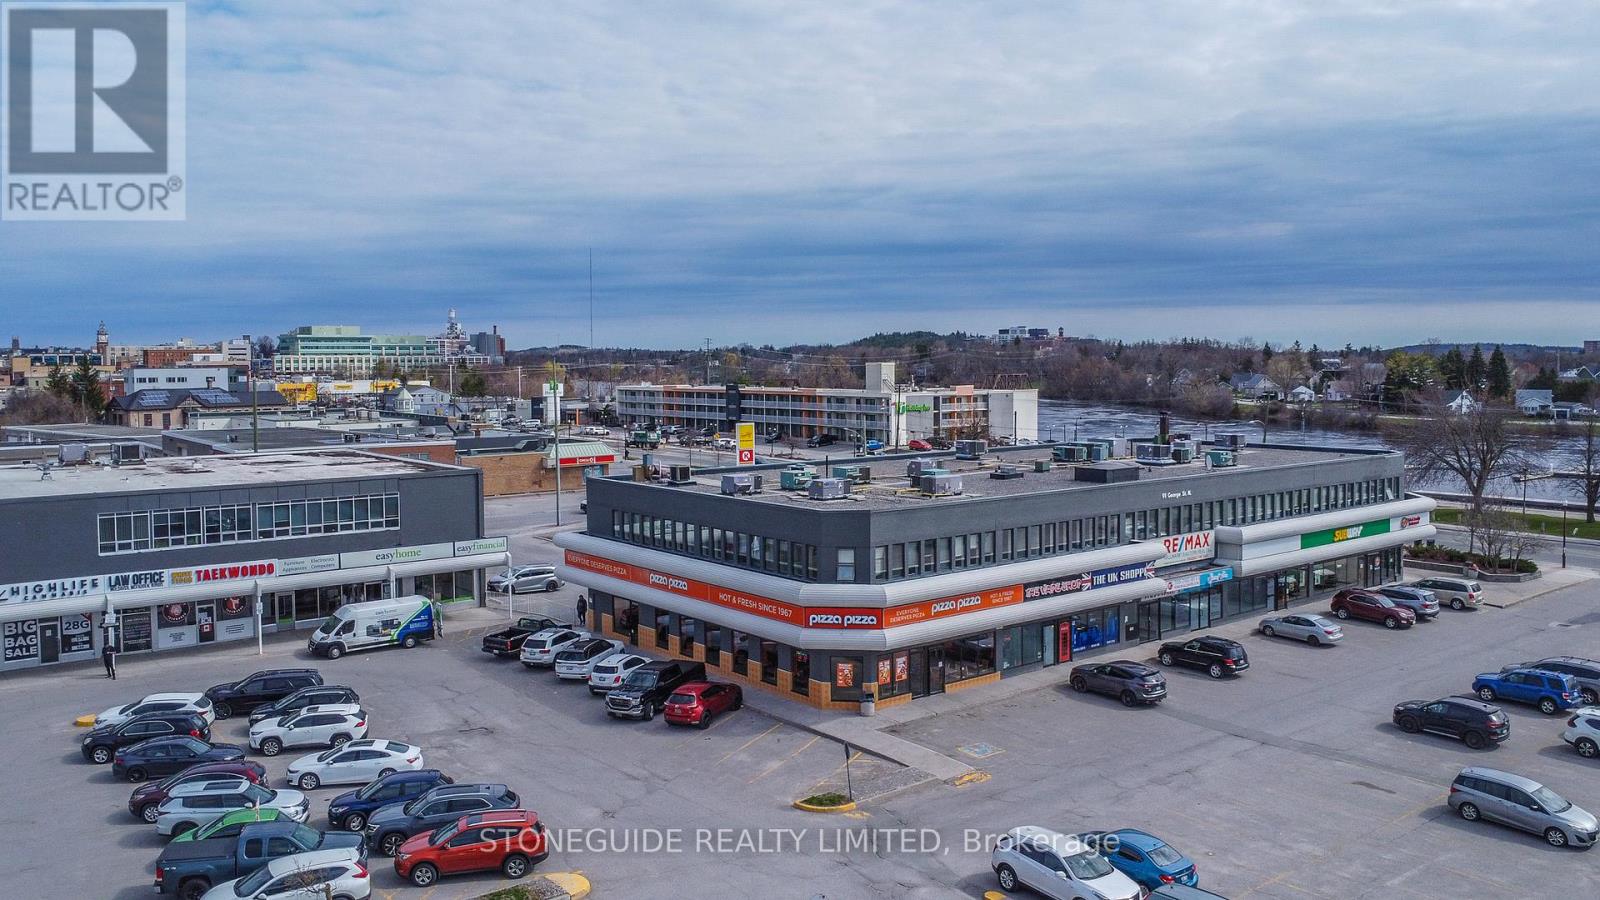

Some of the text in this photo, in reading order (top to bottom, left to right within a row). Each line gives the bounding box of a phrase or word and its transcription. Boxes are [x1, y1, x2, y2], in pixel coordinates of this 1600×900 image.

[1164, 532, 1210, 553] RE/MAX
[108, 574, 130, 587] LAW
[132, 571, 164, 585] OFFICE
[195, 562, 275, 583] TAEKWONDO
[1093, 574, 1106, 585] THE
[1107, 572, 1118, 583] UK
[11, 578, 99, 596] HIGHLIFE
[650, 573, 688, 590] pizza pizza
[23, 589, 88, 601] CANNABIS
[719, 593, 793, 617] HOT & FRESH SINCE 1967
[932, 596, 981, 616] pizza pizza
[64, 620, 90, 631] 28G
[809, 614, 877, 627] pizza pizza
[4, 621, 37, 636] BIG
[4, 635, 37, 648] BAG
[5, 646, 38, 657] SALE
